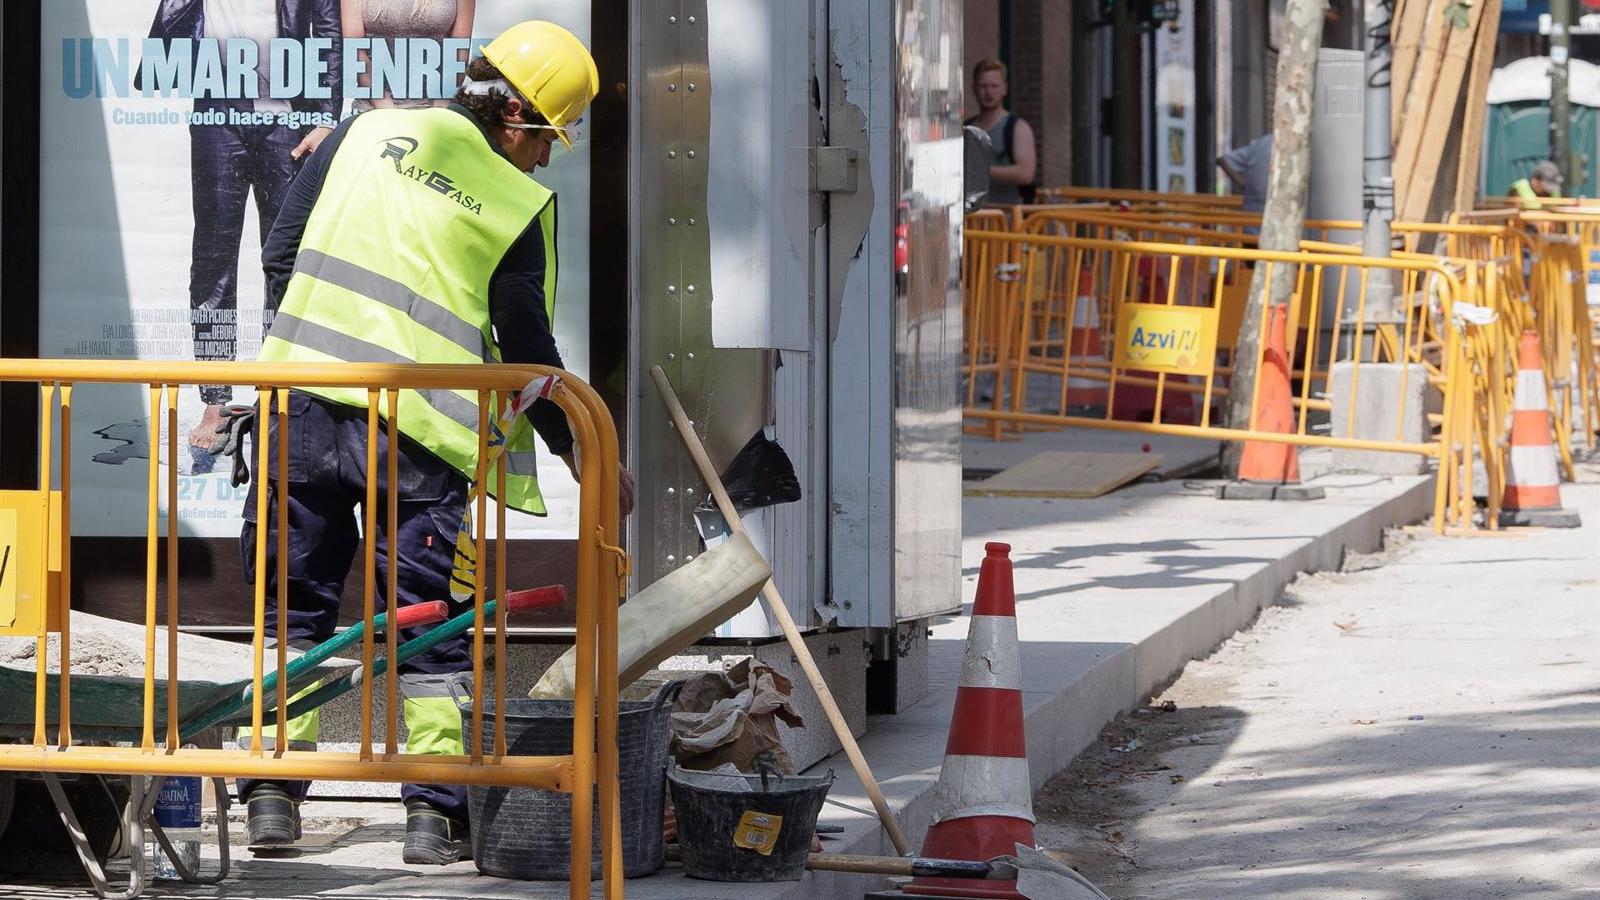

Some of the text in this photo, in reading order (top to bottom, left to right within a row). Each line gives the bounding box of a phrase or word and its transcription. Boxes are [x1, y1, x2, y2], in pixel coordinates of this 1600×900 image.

[62, 38, 494, 98] UN MAR DE ENRE
[113, 108, 179, 125] Cuando
[185, 108, 226, 125] todo
[229, 108, 275, 125] hace
[277, 112, 338, 130] aguas,
[209, 309, 237, 323] PICTURES
[205, 341, 231, 356] MICHAEL
[1130, 326, 1176, 349] Azvi
[178, 478, 207, 501] 27
